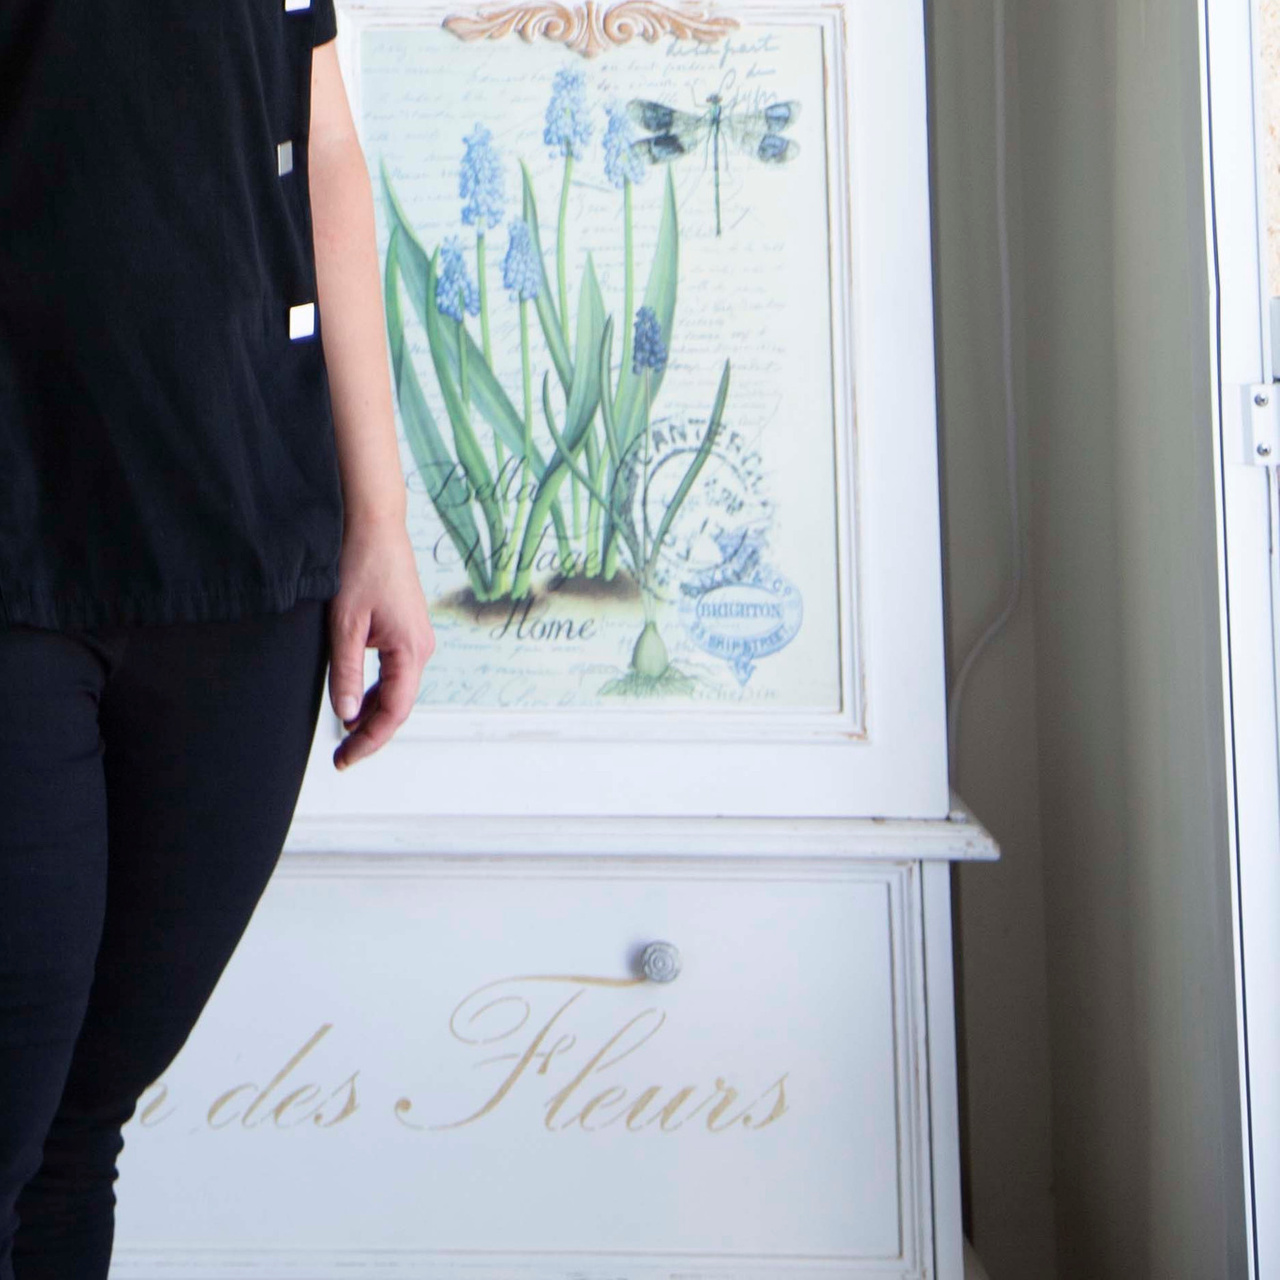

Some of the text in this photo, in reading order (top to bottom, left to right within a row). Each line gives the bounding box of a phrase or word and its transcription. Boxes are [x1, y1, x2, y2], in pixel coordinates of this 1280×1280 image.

[697, 600, 783, 619] BRIGHTON
[206, 974, 791, 1132] des Fleurs
